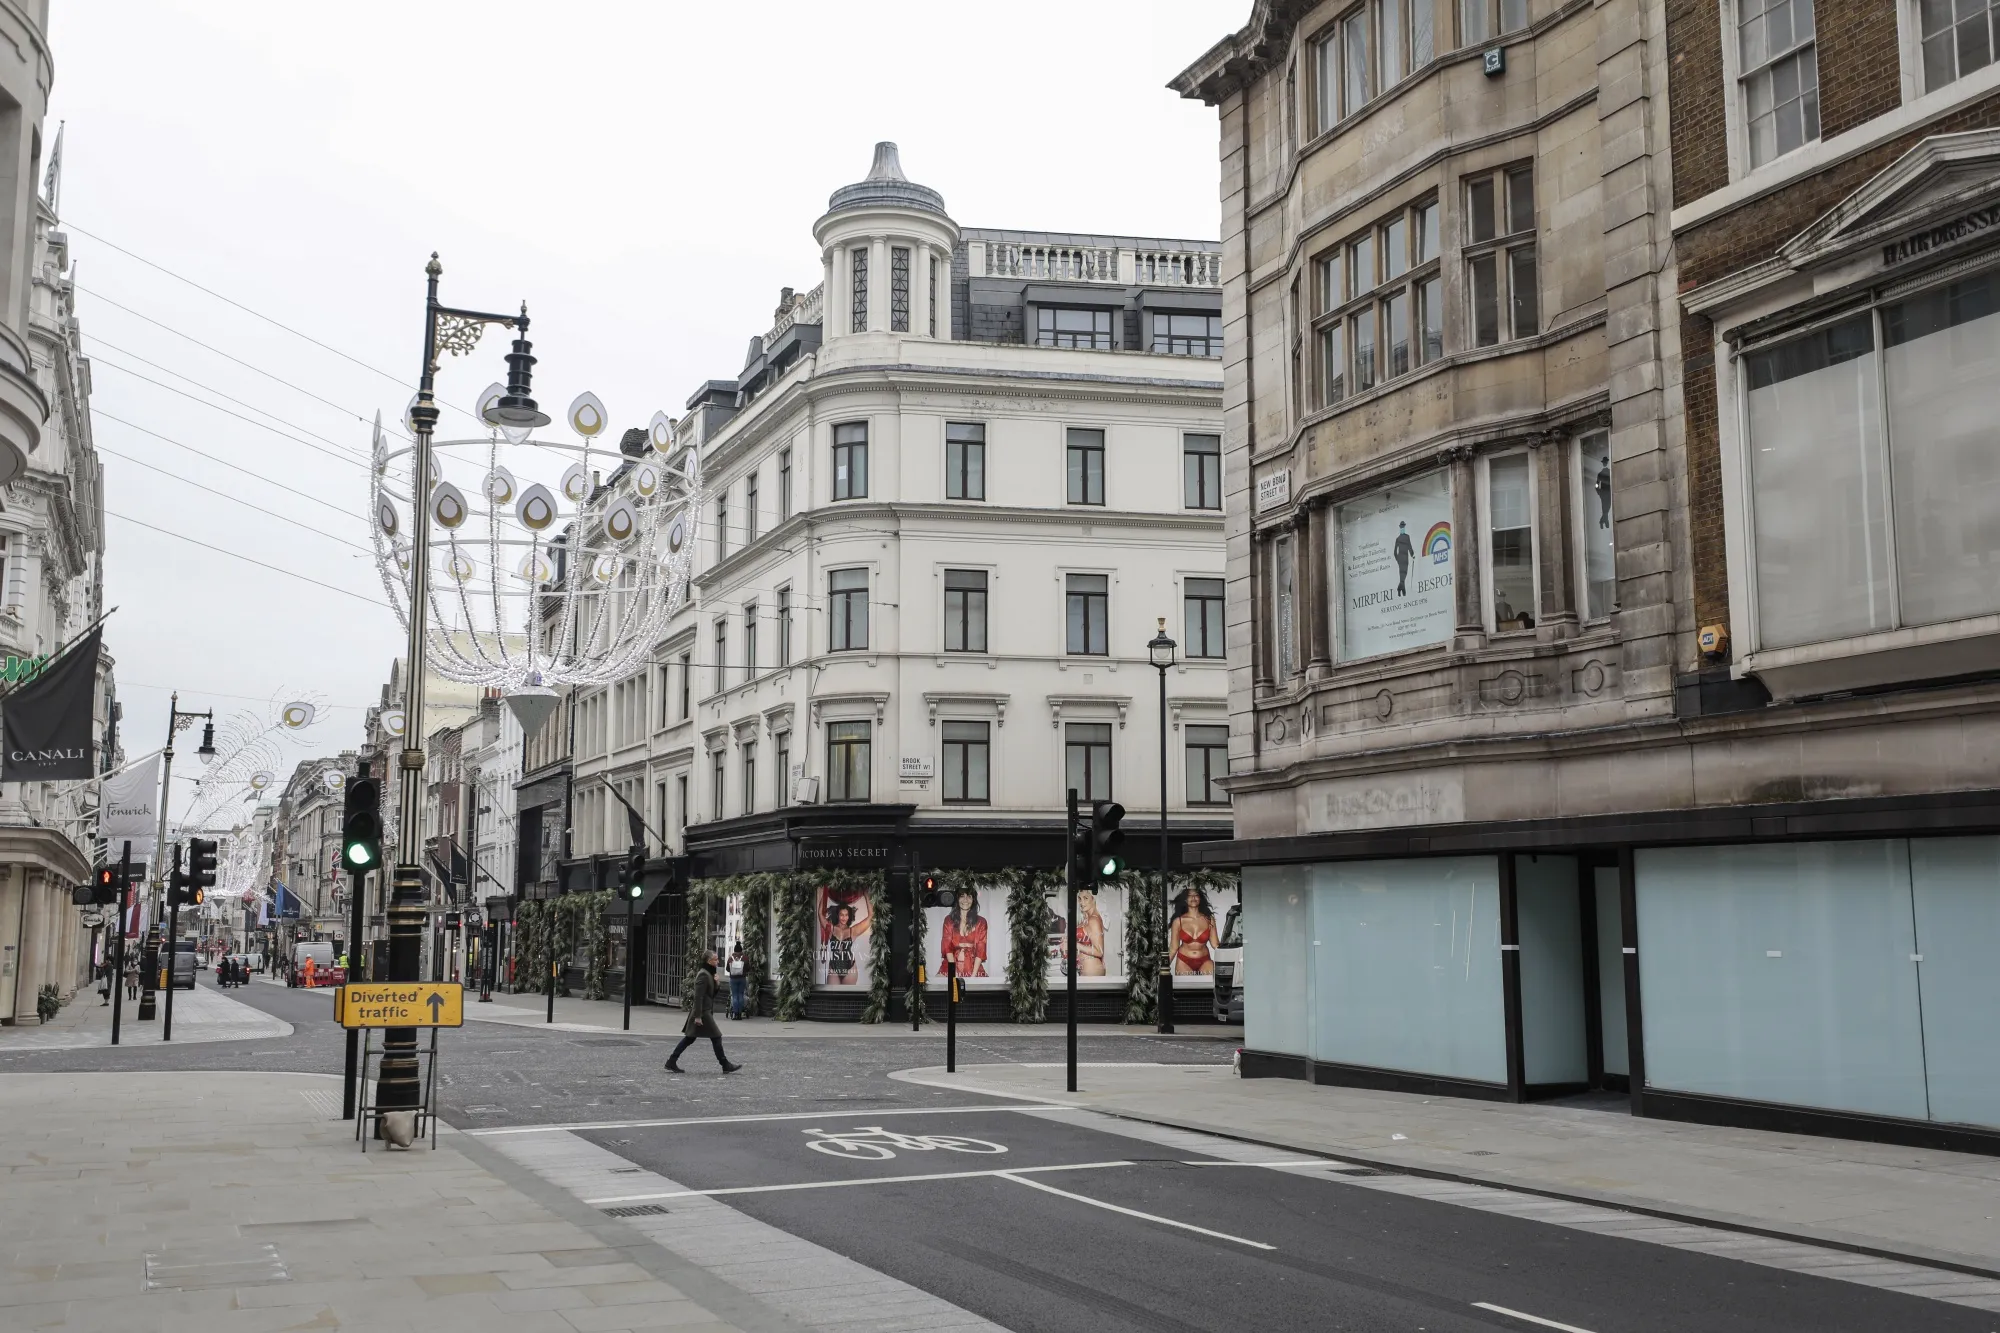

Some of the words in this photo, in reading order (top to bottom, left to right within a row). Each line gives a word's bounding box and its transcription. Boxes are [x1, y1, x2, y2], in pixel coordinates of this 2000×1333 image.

[1260, 480, 1271, 491] NEW
[1272, 473, 1286, 487] BOND
[1260, 486, 1278, 501] STREET
[1434, 551, 1448, 563] NHS
[1352, 588, 1394, 609] MIRPURI
[1380, 603, 1402, 614] SERVING
[1403, 599, 1419, 609] SINCE
[11, 748, 85, 762] CANALI
[106, 803, 152, 819] Fenwick
[847, 847, 889, 857] SECRET
[829, 940, 852, 950] GIFT
[351, 991, 418, 1003] Diverted
[358, 1006, 409, 1019] traffic
